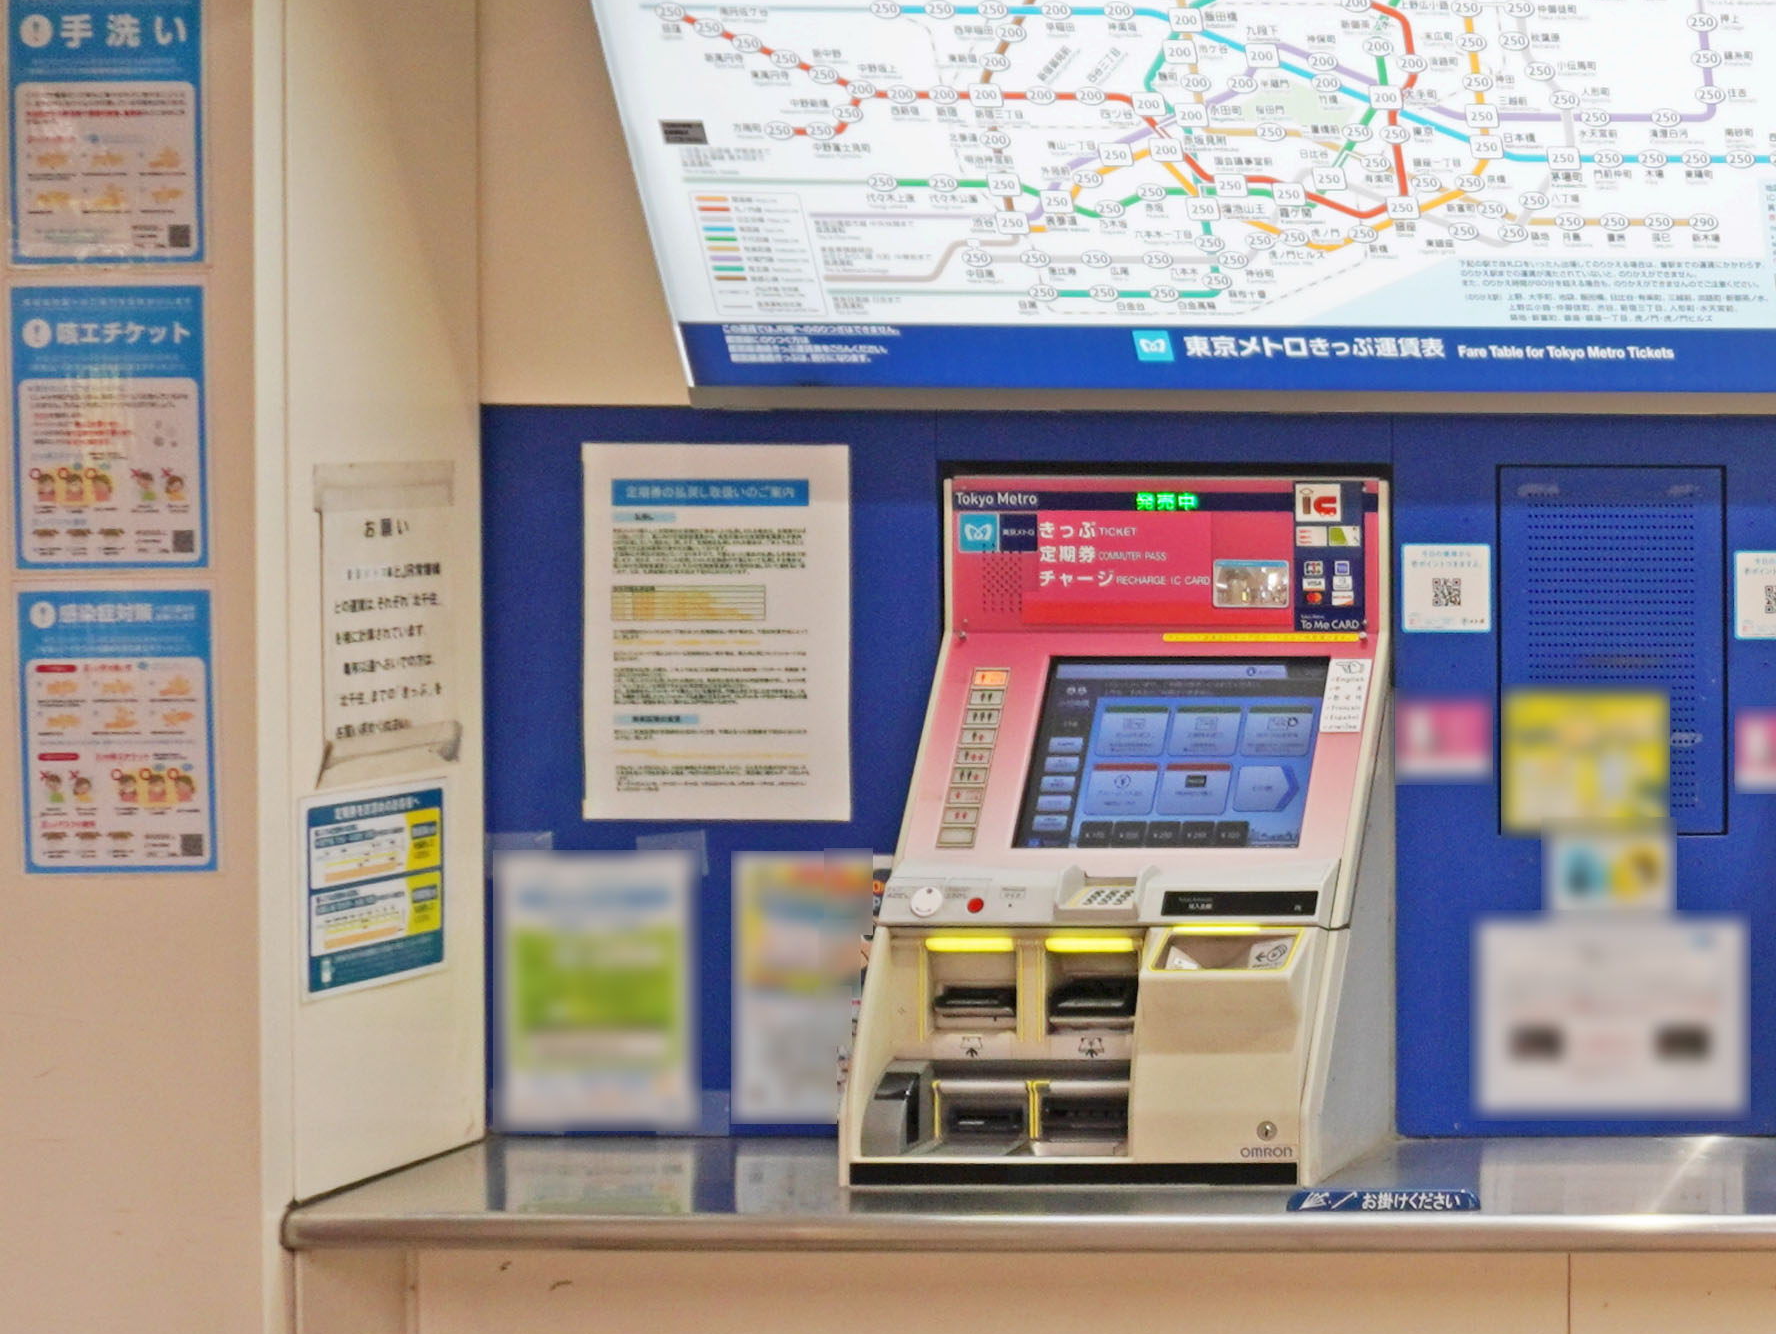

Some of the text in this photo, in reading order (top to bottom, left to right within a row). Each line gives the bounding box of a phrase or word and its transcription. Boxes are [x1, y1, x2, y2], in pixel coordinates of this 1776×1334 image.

[1175, 15, 1196, 25] 200
[60, 13, 187, 48] 手洗い
[1504, 133, 1536, 143] 日本橋
[56, 322, 190, 344] 咳エチケット
[1184, 336, 1674, 360] 東京メトロきっぷ運賃表 Fare Table for Tokyo Metro Tickets
[956, 492, 1037, 507] Tokyo Metro
[1137, 493, 1198, 510] 発売中
[364, 518, 410, 537] お願い
[1039, 522, 1137, 538] きっぷ TICKET
[1040, 546, 1166, 563] 定期券 COMMUTER PASS
[1040, 570, 1210, 587] チャージ RECHARGE IC CARD
[1301, 619, 1359, 629] To Me CARD
[1362, 1192, 1461, 1209] お掛けください
